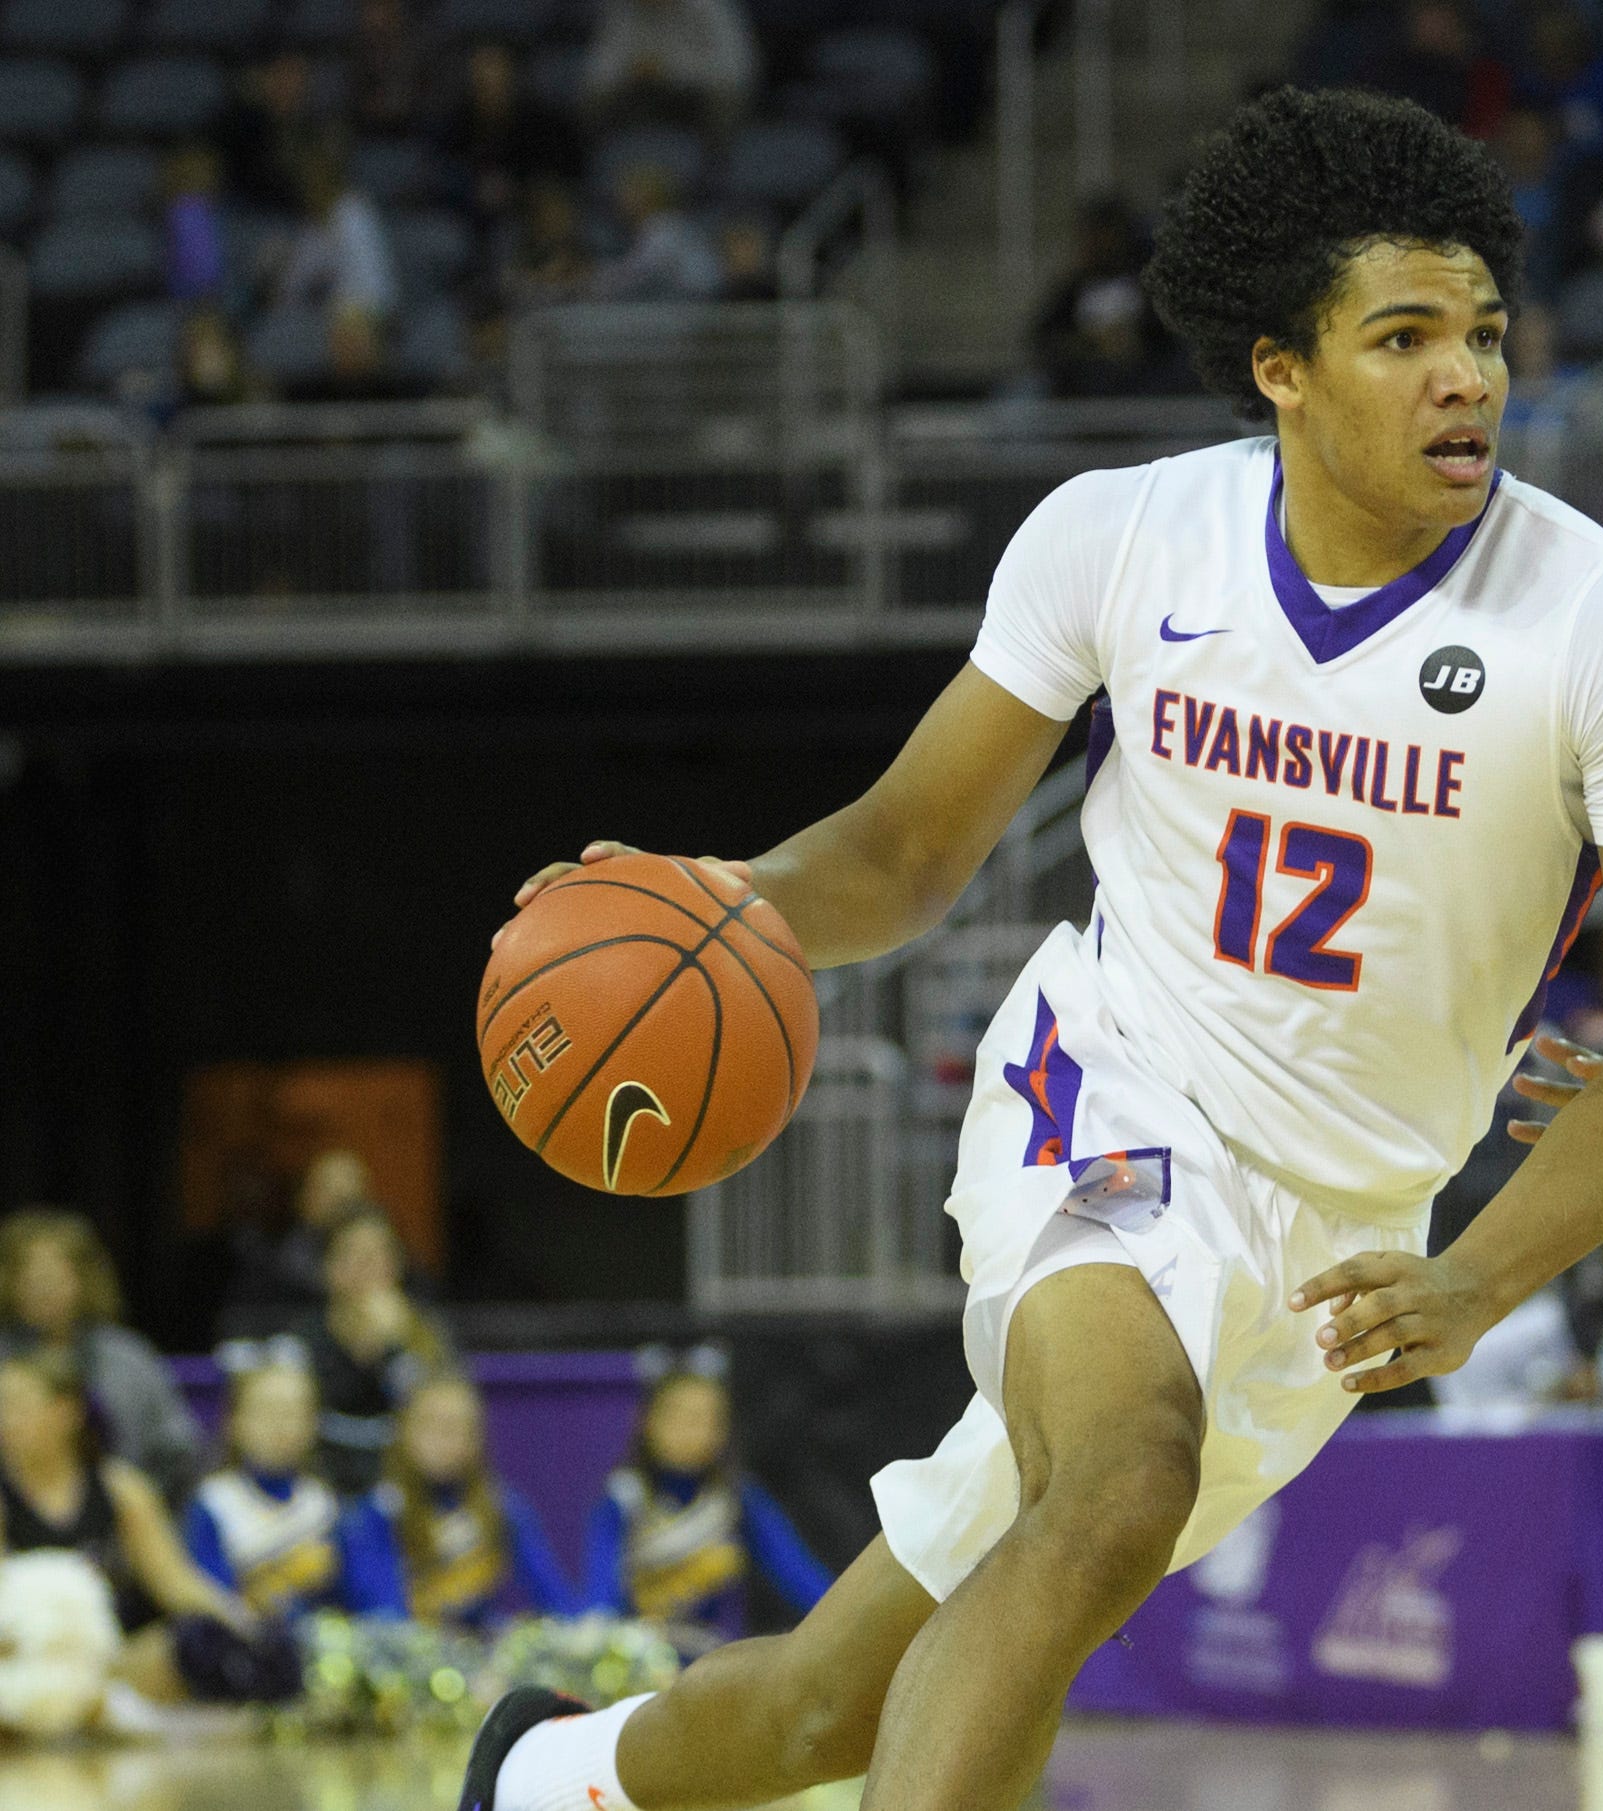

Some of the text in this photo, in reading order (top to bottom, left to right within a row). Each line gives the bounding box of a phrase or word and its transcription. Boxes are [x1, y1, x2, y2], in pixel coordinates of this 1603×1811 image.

[1423, 665, 1481, 694] JB
[1150, 688, 1466, 819] EVANSVILLE
[1214, 808, 1374, 992] 12
[493, 1015, 573, 1121] ELITE
